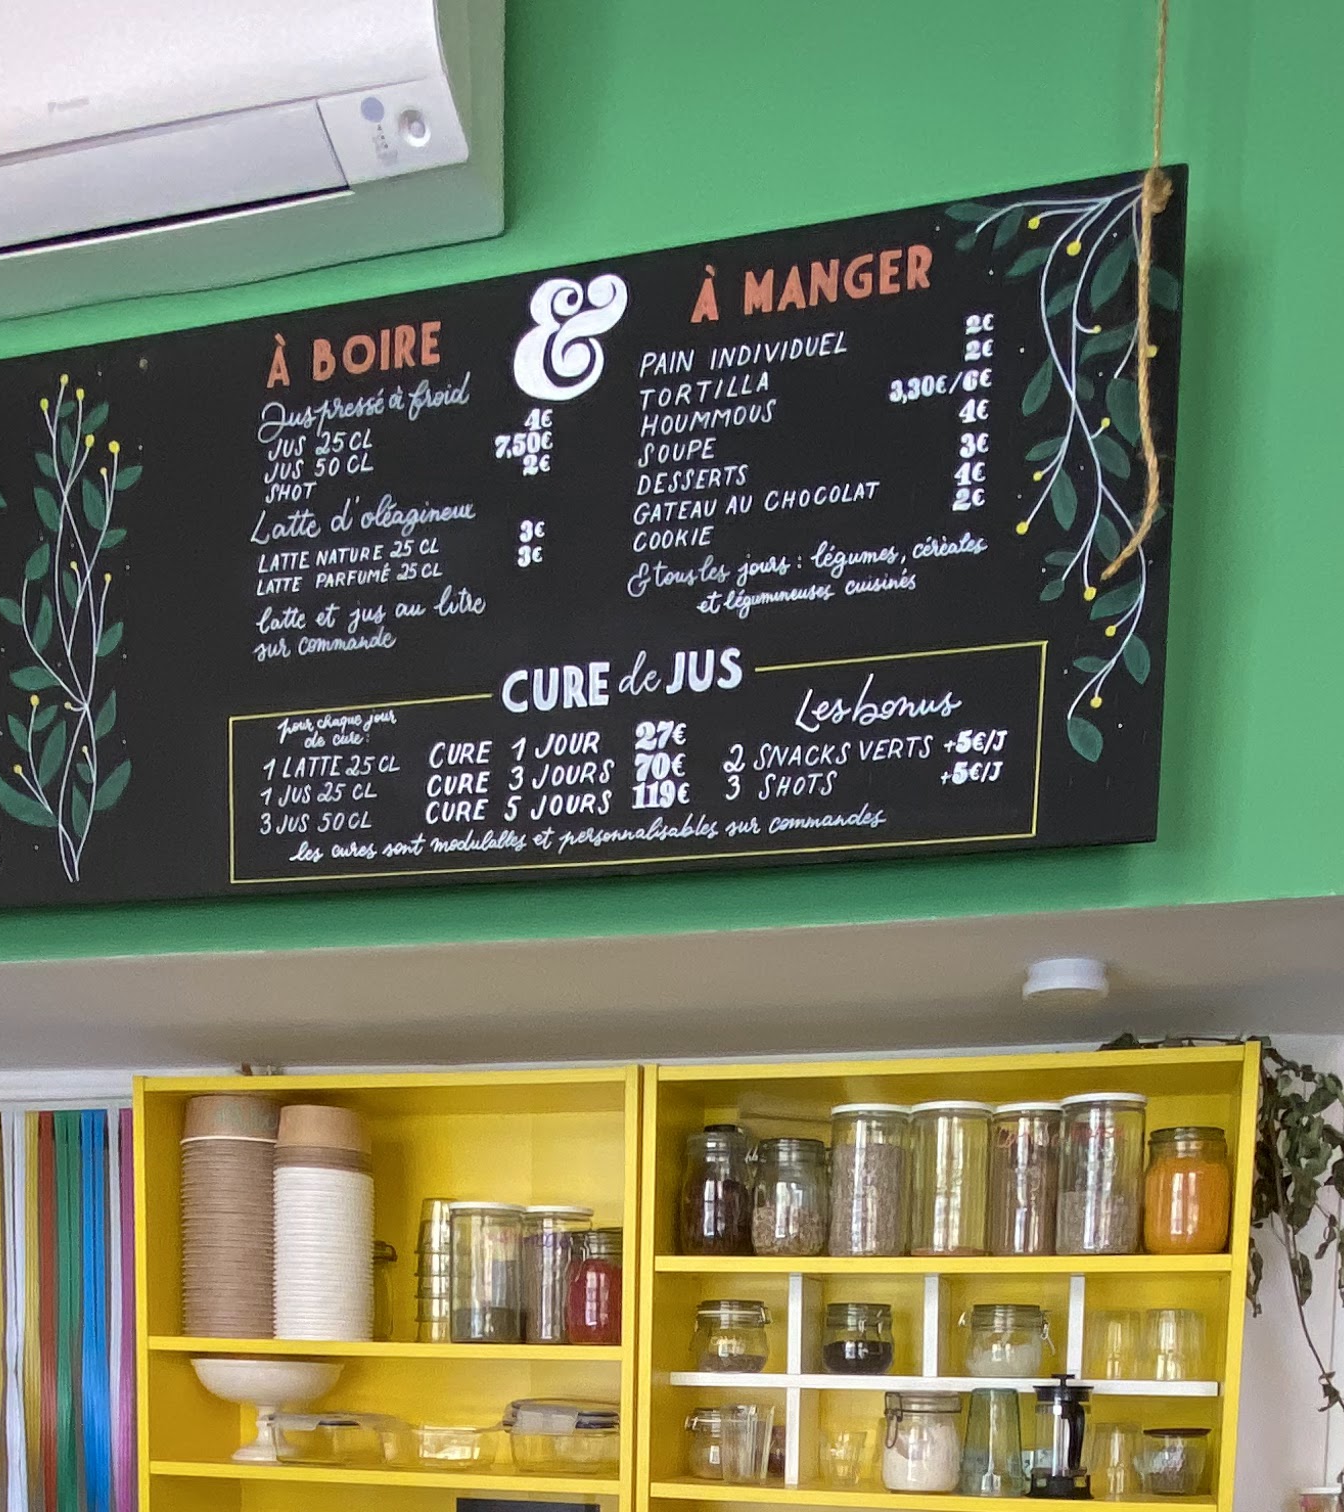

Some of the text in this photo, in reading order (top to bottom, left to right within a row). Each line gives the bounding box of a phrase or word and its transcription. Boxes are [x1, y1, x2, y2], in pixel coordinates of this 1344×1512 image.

[689, 244, 933, 323] À MANGER
[964, 313, 995, 335] 2€
[266, 320, 442, 389] À BOIRE
[639, 331, 849, 378] PAIN INDIVIDUEL
[964, 338, 994, 361] 2€
[258, 370, 471, 443] Jus pressé à froid
[640, 371, 770, 411] TORTILLA
[523, 408, 553, 430] 4€
[640, 398, 777, 438] HOUMMOUS
[958, 398, 990, 424] 4€
[268, 428, 373, 461] JUS 25 CL
[494, 431, 554, 459] 7,50€
[638, 437, 717, 468] SOUPE
[958, 432, 990, 459] 3€
[264, 452, 374, 485] JUS 50 CL
[522, 453, 551, 477] 2€
[636, 463, 749, 496] DESSERTS
[954, 461, 987, 487] 4€
[265, 482, 317, 504] SHOT
[633, 480, 881, 526] GATEAU AU CHOCOLAT
[951, 488, 986, 513] 2€
[250, 509, 321, 545] Latte
[519, 520, 545, 543] 3€
[632, 525, 714, 553] COOKIE
[258, 537, 440, 575] LATTE NATURE 25 CL
[517, 544, 543, 568] 3€
[652, 553, 731, 588] tous les
[256, 562, 443, 596] LATTE PARFUMÉ 25 CL
[696, 568, 917, 615] et cuisinés
[255, 585, 488, 635] latte et jus au litre
[253, 626, 398, 662] sur commande
[501, 647, 744, 714] CURE de JUS
[795, 673, 962, 733] Les bonus
[277, 709, 397, 744] pour chaque jour
[304, 731, 326, 748] de
[429, 721, 686, 770] CURE JOUR 27€
[723, 735, 933, 773] 2 SNACKS VERTS
[282, 755, 401, 779] LATTE 25 CL
[426, 753, 686, 799] CURE 3 JOURS 70€
[278, 782, 377, 807] JUS 25 CL
[425, 780, 690, 825] CURE 5 JOURS 119€
[726, 771, 838, 801] 3 SHOTS
[260, 812, 310, 835] 3 JUS
[289, 802, 887, 863] les cures sont modulables et personnalisables sur commandes
